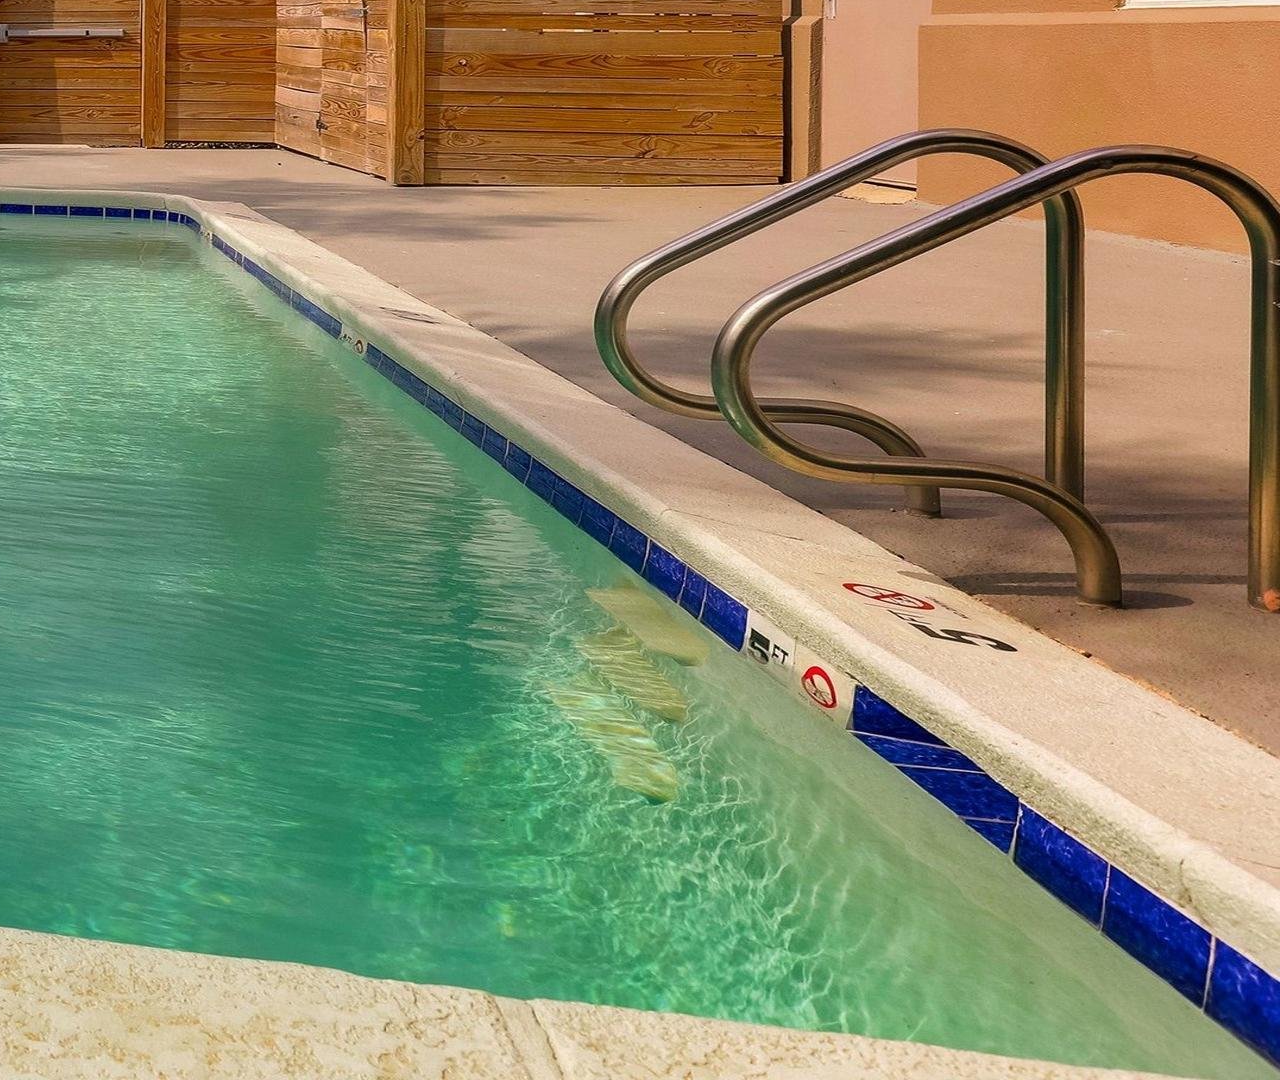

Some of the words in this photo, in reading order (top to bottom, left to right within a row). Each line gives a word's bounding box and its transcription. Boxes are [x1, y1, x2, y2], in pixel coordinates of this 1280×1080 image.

[747, 627, 771, 665] 5
[771, 643, 789, 665] FT
[908, 622, 1018, 652] 5
